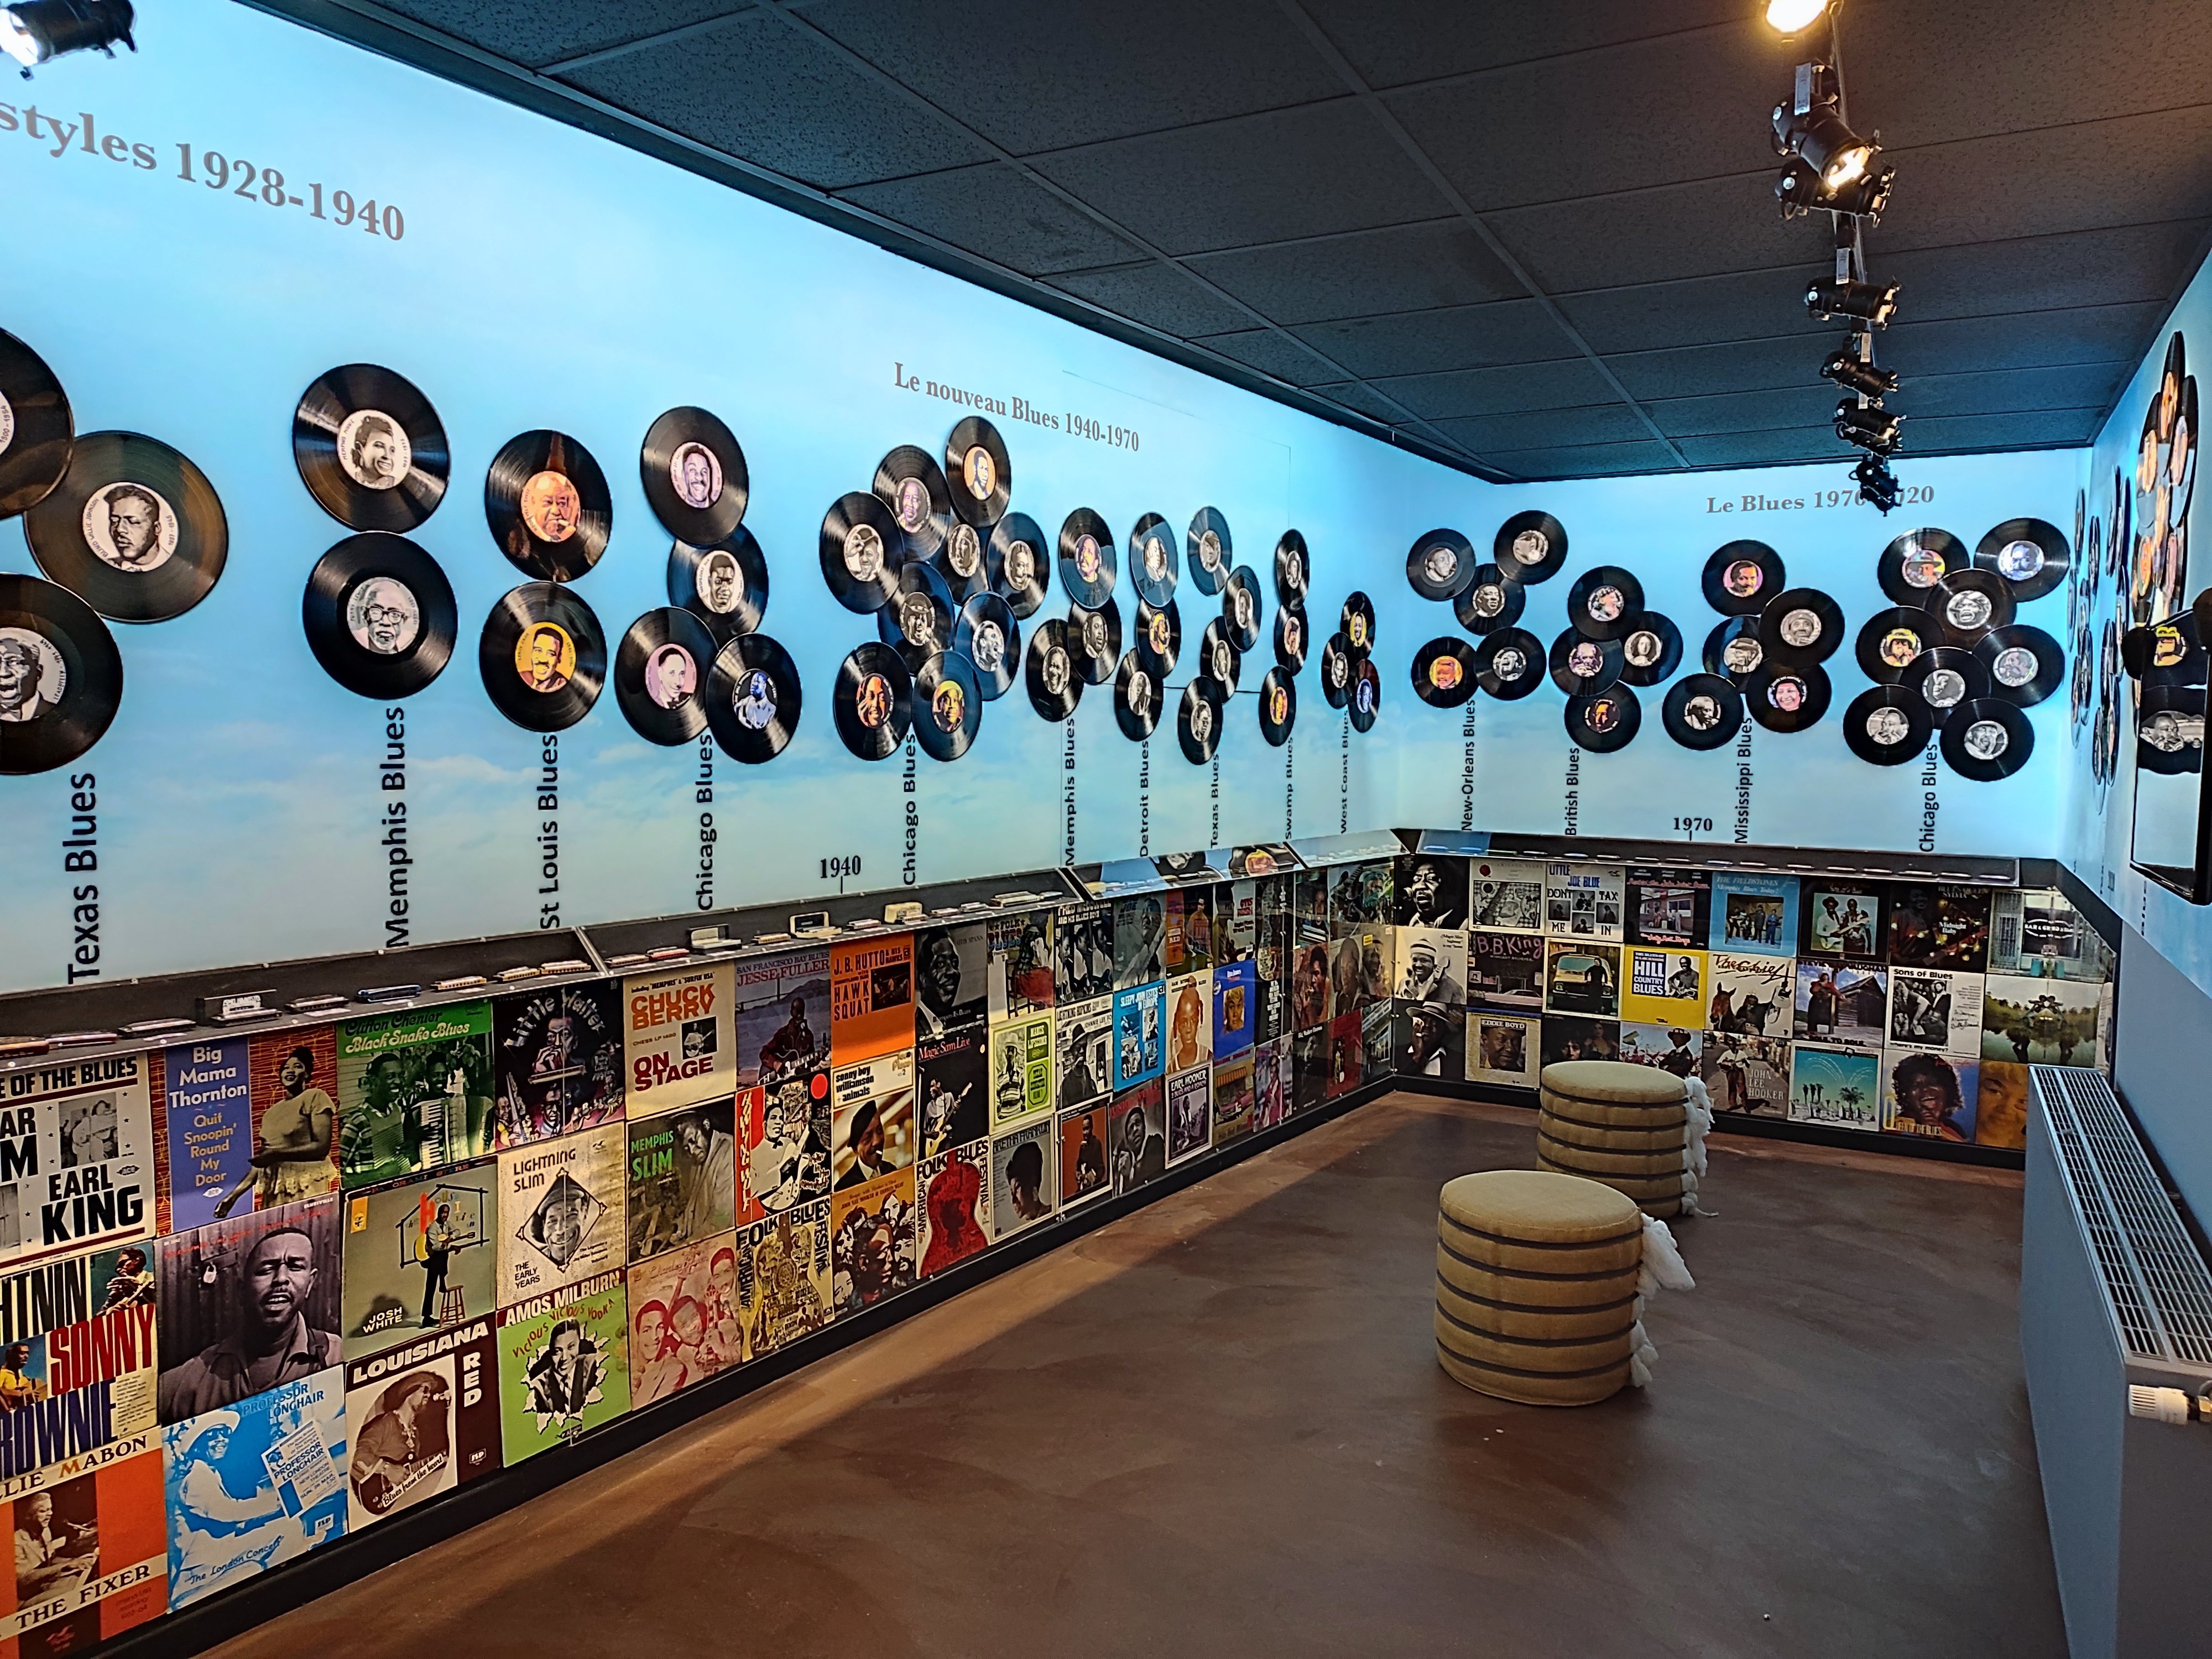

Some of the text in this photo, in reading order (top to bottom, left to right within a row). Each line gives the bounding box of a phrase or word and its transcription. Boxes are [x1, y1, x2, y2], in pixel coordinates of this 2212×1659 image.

[0, 102, 404, 241] styles 1928-1940
[894, 362, 1139, 452] Le nouveau Blues 1940-1970
[1707, 497, 1734, 513] Le
[1740, 494, 1805, 512] Blues
[1462, 699, 1475, 831] New-Orleans Blues
[1065, 717, 1077, 866] Memphis Blues
[1565, 748, 1579, 836] British Blues
[1734, 717, 1754, 843] Mississippi Blues
[902, 733, 919, 886] Chicago Blues
[1140, 740, 1149, 857] Detroit Blues
[1211, 753, 1219, 849] Texas Blues
[1919, 744, 1939, 853] Chicago Blues
[380, 706, 413, 948] Memphis Blues
[536, 734, 561, 930] St Louis Blues
[696, 733, 717, 911] Chicago Blues
[1673, 817, 1713, 831] 1970
[62, 773, 100, 985] Texas Blues
[820, 855, 862, 879] 1940
[1550, 864, 1571, 876] LITTLE
[1599, 891, 1619, 901] TAX
[1000, 919, 1020, 930] FOLK
[1551, 922, 1611, 936] ME IN
[753, 958, 793, 972] FRANCISCO
[808, 951, 830, 961] BLUES
[855, 950, 885, 969] HUTTO
[1634, 960, 1665, 977] HILL
[1894, 968, 1916, 977] Sons
[737, 972, 779, 987] JESSE
[780, 960, 830, 978] FULLER
[1634, 976, 1664, 985] COUNTRY
[630, 983, 716, 1014] CHUCK
[834, 982, 869, 1003] HAWK
[1633, 984, 1664, 995] BLUES
[345, 1010, 444, 1036] Clifton Chenier
[503, 990, 605, 1047] Little Walter
[632, 1002, 711, 1030] BERRY
[834, 998, 869, 1021] SQUAT
[346, 1022, 470, 1053] Black Snake Blues
[1481, 1019, 1525, 1030] EDDIE BOYD
[193, 1047, 222, 1065] Big
[634, 1051, 670, 1076] ON
[919, 1045, 940, 1060] Magic
[10, 1056, 138, 1097] OF THE BLUES
[179, 1067, 236, 1087] Mama
[634, 1056, 714, 1092] STAGE
[836, 1066, 870, 1082] sonny boy
[836, 1075, 874, 1092] williamson
[1171, 1079, 1183, 1091] EARL
[1185, 1070, 1207, 1086] HOOKER
[1749, 1078, 1764, 1088] LEE
[169, 1085, 247, 1109] Thornton
[842, 1087, 870, 1102] animals
[1748, 1088, 1784, 1100] HOOKER
[194, 1113, 222, 1128] Quit
[190, 1140, 229, 1158] Round
[631, 1130, 674, 1154] MEMPHIS
[201, 1159, 220, 1171] My
[632, 1147, 673, 1182] SLIM
[917, 1140, 989, 1181] FOLK BLUES
[48, 1163, 113, 1202] EARL
[195, 1172, 227, 1187] Door
[979, 1157, 988, 1206] FESTIVAL
[41, 1185, 143, 1246] KING
[790, 1198, 831, 1227] BLUES
[917, 1181, 926, 1233] AMERICAN
[515, 1261, 530, 1274] THE
[515, 1267, 538, 1282] EARLY
[738, 1246, 755, 1307] AMERICAN
[515, 1275, 540, 1290] YEARS
[504, 1270, 620, 1328] AMOS MILBURN
[362, 1315, 403, 1334] WHITE
[368, 1306, 403, 1324] JOSH
[50, 1303, 155, 1396] SONNY
[353, 1321, 488, 1384] LOUISIANA
[513, 1323, 549, 1359] VICIOUS
[463, 1352, 482, 1407] RED
[243, 1384, 309, 1417] PROFESSOR
[268, 1390, 325, 1420] LONGHAIR
[59, 1436, 148, 1479] MABON
[274, 1441, 321, 1479] PROFESSOR
[282, 1448, 324, 1482] LONGHAIR
[383, 1489, 402, 1507] Blues
[416, 1469, 427, 1482] the
[210, 1554, 244, 1577] London
[15, 1600, 66, 1631] THE
[79, 1564, 150, 1609] FIXER
